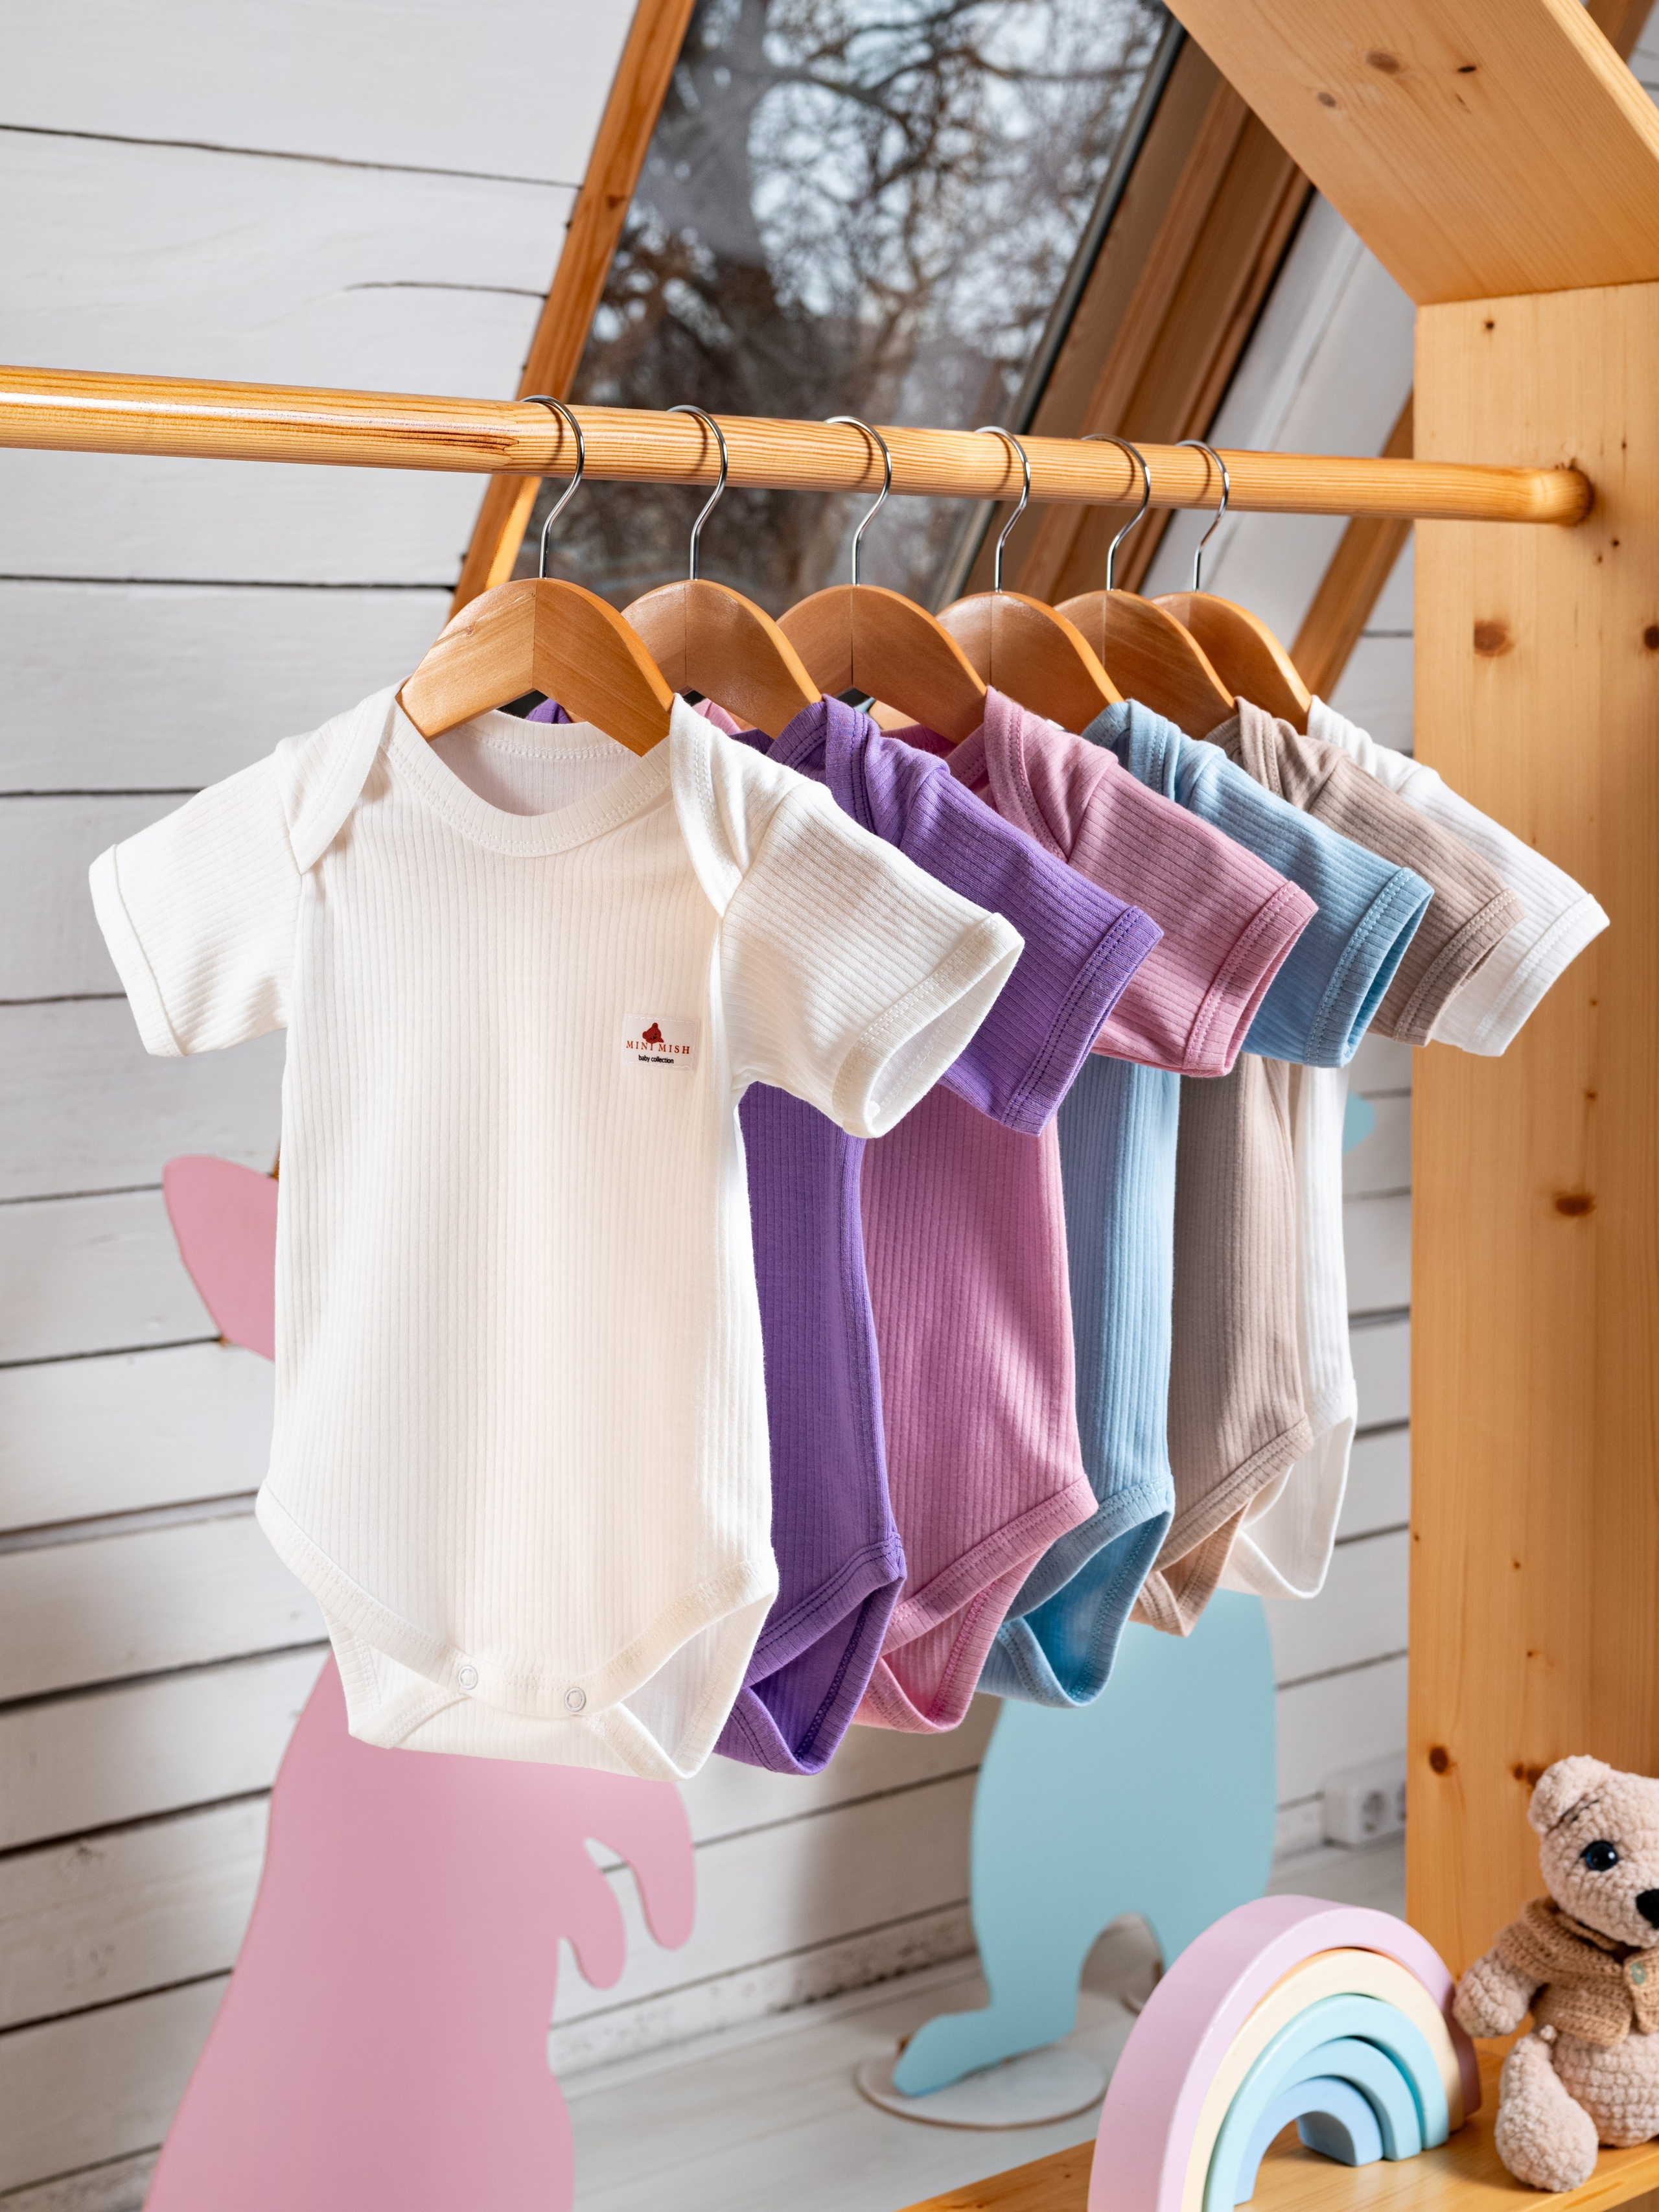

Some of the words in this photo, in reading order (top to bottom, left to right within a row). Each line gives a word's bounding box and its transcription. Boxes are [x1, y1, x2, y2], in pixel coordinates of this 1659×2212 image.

[626, 1040, 653, 1051] MINI
[658, 1043, 690, 1054] MISH
[651, 1056, 674, 1064] collection
